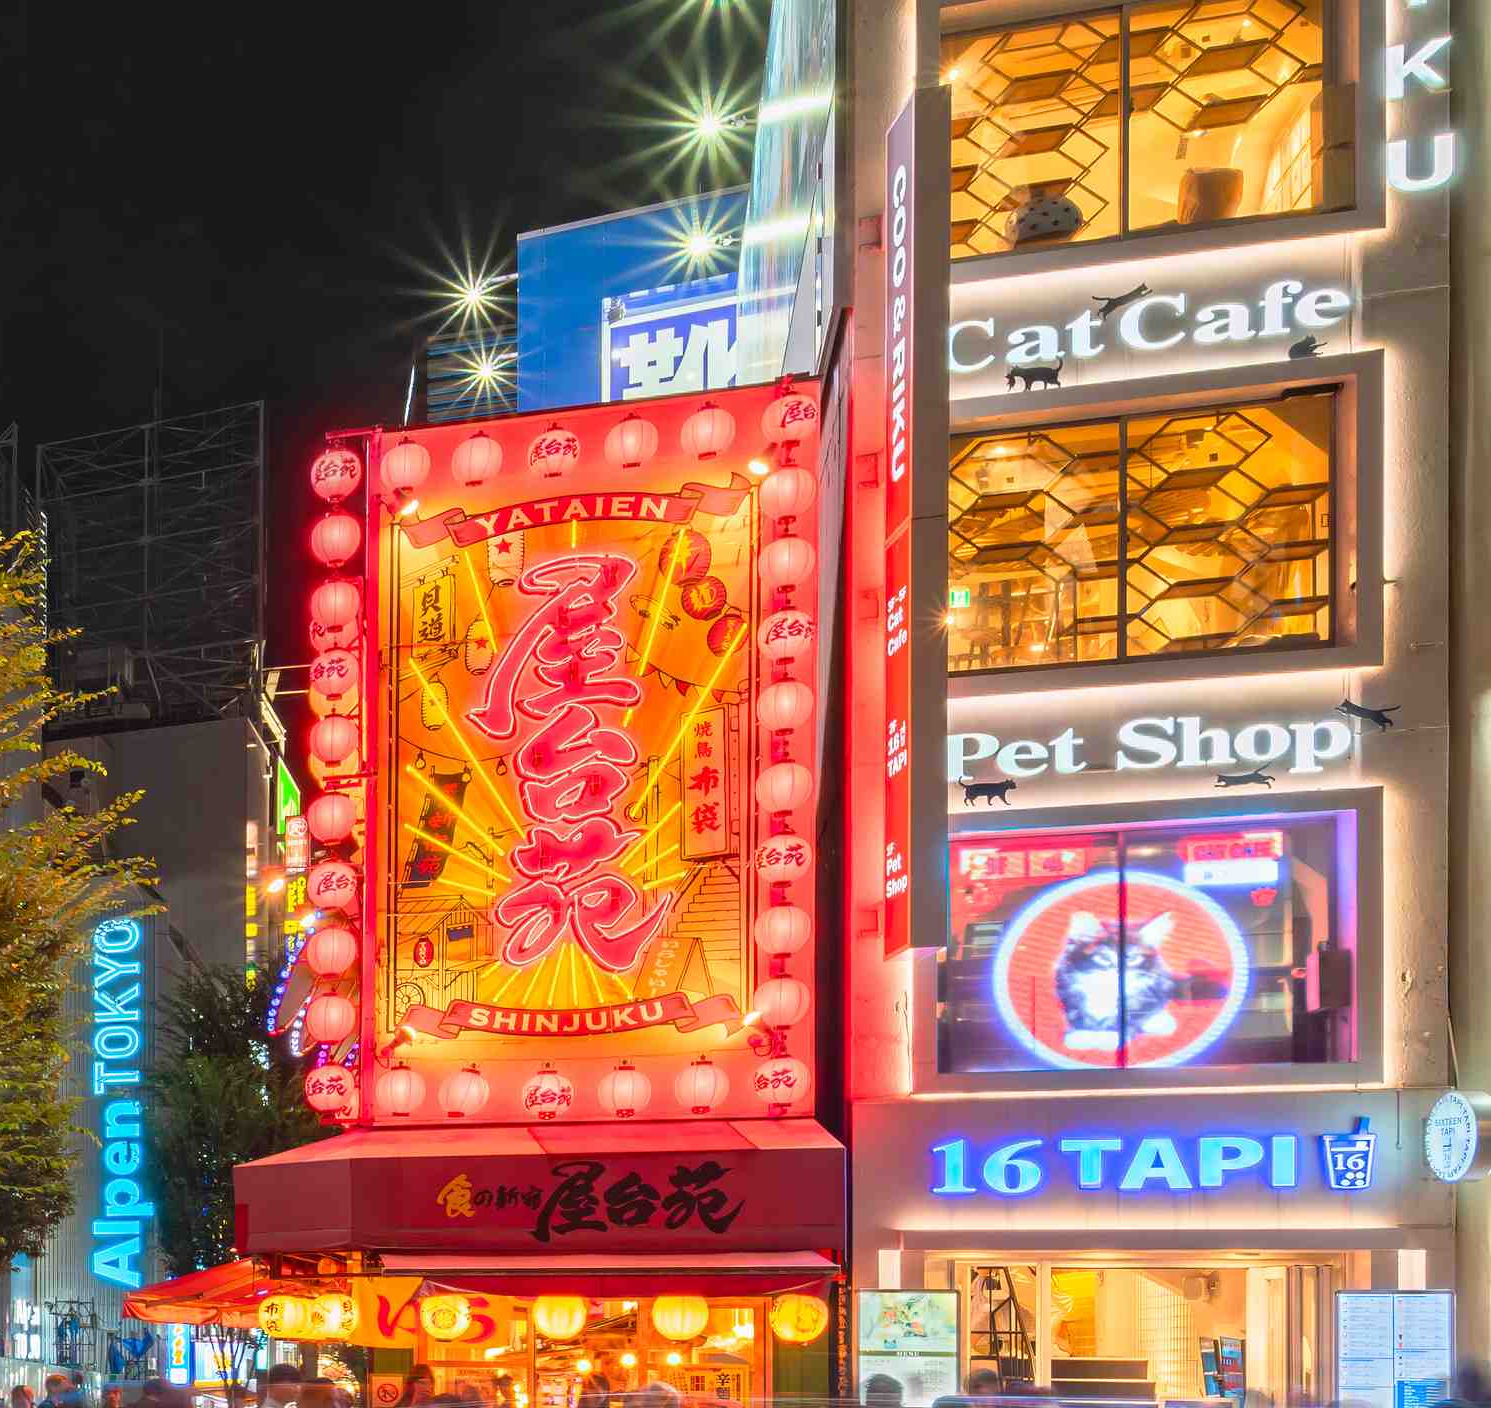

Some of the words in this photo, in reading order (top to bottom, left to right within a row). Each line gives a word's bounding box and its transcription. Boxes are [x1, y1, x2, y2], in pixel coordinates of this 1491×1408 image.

[948, 309, 1105, 374] Cat
[1120, 280, 1352, 350] Cafe
[476, 496, 671, 536] YATAIEN
[887, 605, 904, 633] Cat
[887, 628, 908, 657] Cafe
[468, 552, 672, 973] 屋台苑
[886, 748, 908, 778] TAPI
[947, 726, 1088, 781] Pet
[1115, 716, 1352, 774] Shop
[885, 853, 902, 877] Pet
[885, 874, 908, 899] Shop
[93, 918, 141, 1095] TOKYO
[468, 999, 667, 1034] SHINJUKU
[932, 1137, 1044, 1194] 16
[1060, 1136, 1299, 1190] TAPI
[1333, 1151, 1366, 1172] 16
[92, 1099, 154, 1288] Alpen
[530, 1159, 746, 1243] 屋台苑
